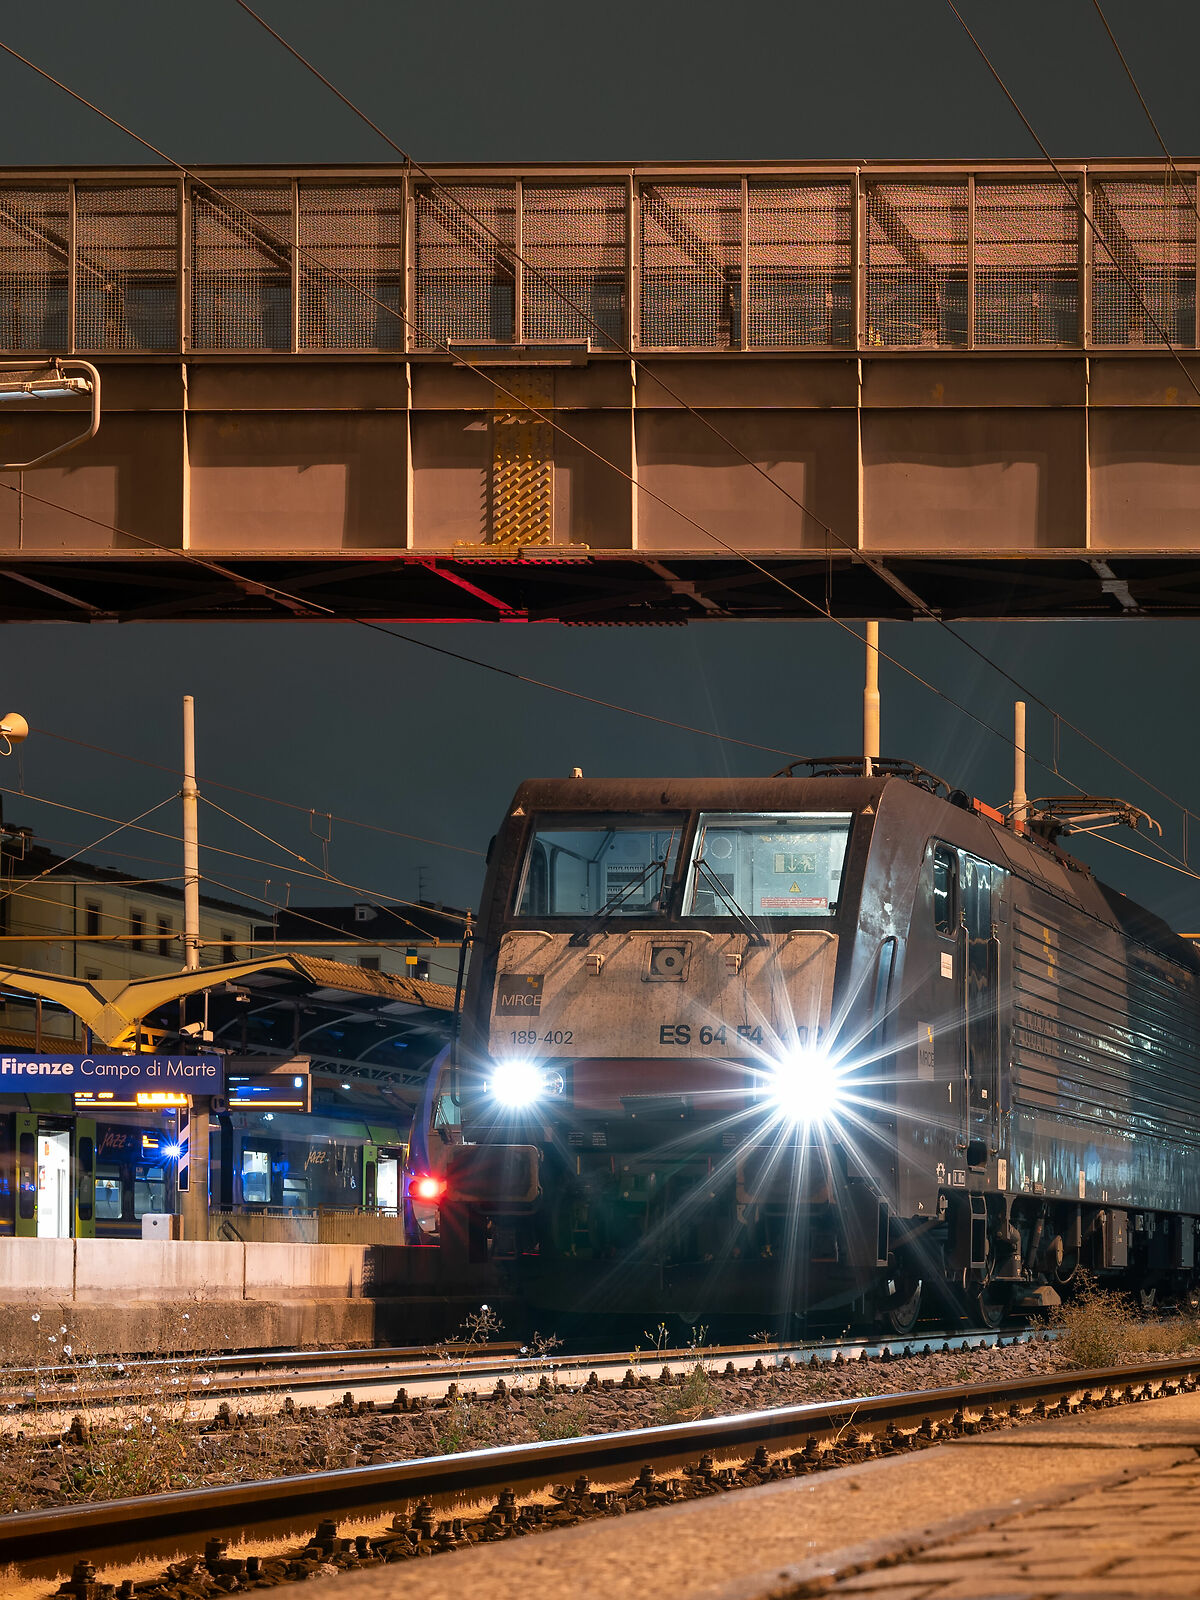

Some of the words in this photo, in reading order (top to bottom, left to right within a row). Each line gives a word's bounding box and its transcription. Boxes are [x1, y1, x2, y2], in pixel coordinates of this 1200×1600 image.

[501, 994, 542, 1007] MRCE
[510, 1030, 573, 1045] 189-402
[659, 1024, 691, 1045] ES
[699, 1025, 727, 1045] 64
[736, 1025, 763, 1045] F4
[1, 1058, 74, 1075] Firenze
[80, 1059, 141, 1079] Campo
[146, 1060, 161, 1076] di
[166, 1060, 216, 1076] Marte
[304, 1145, 327, 1171] jazz
